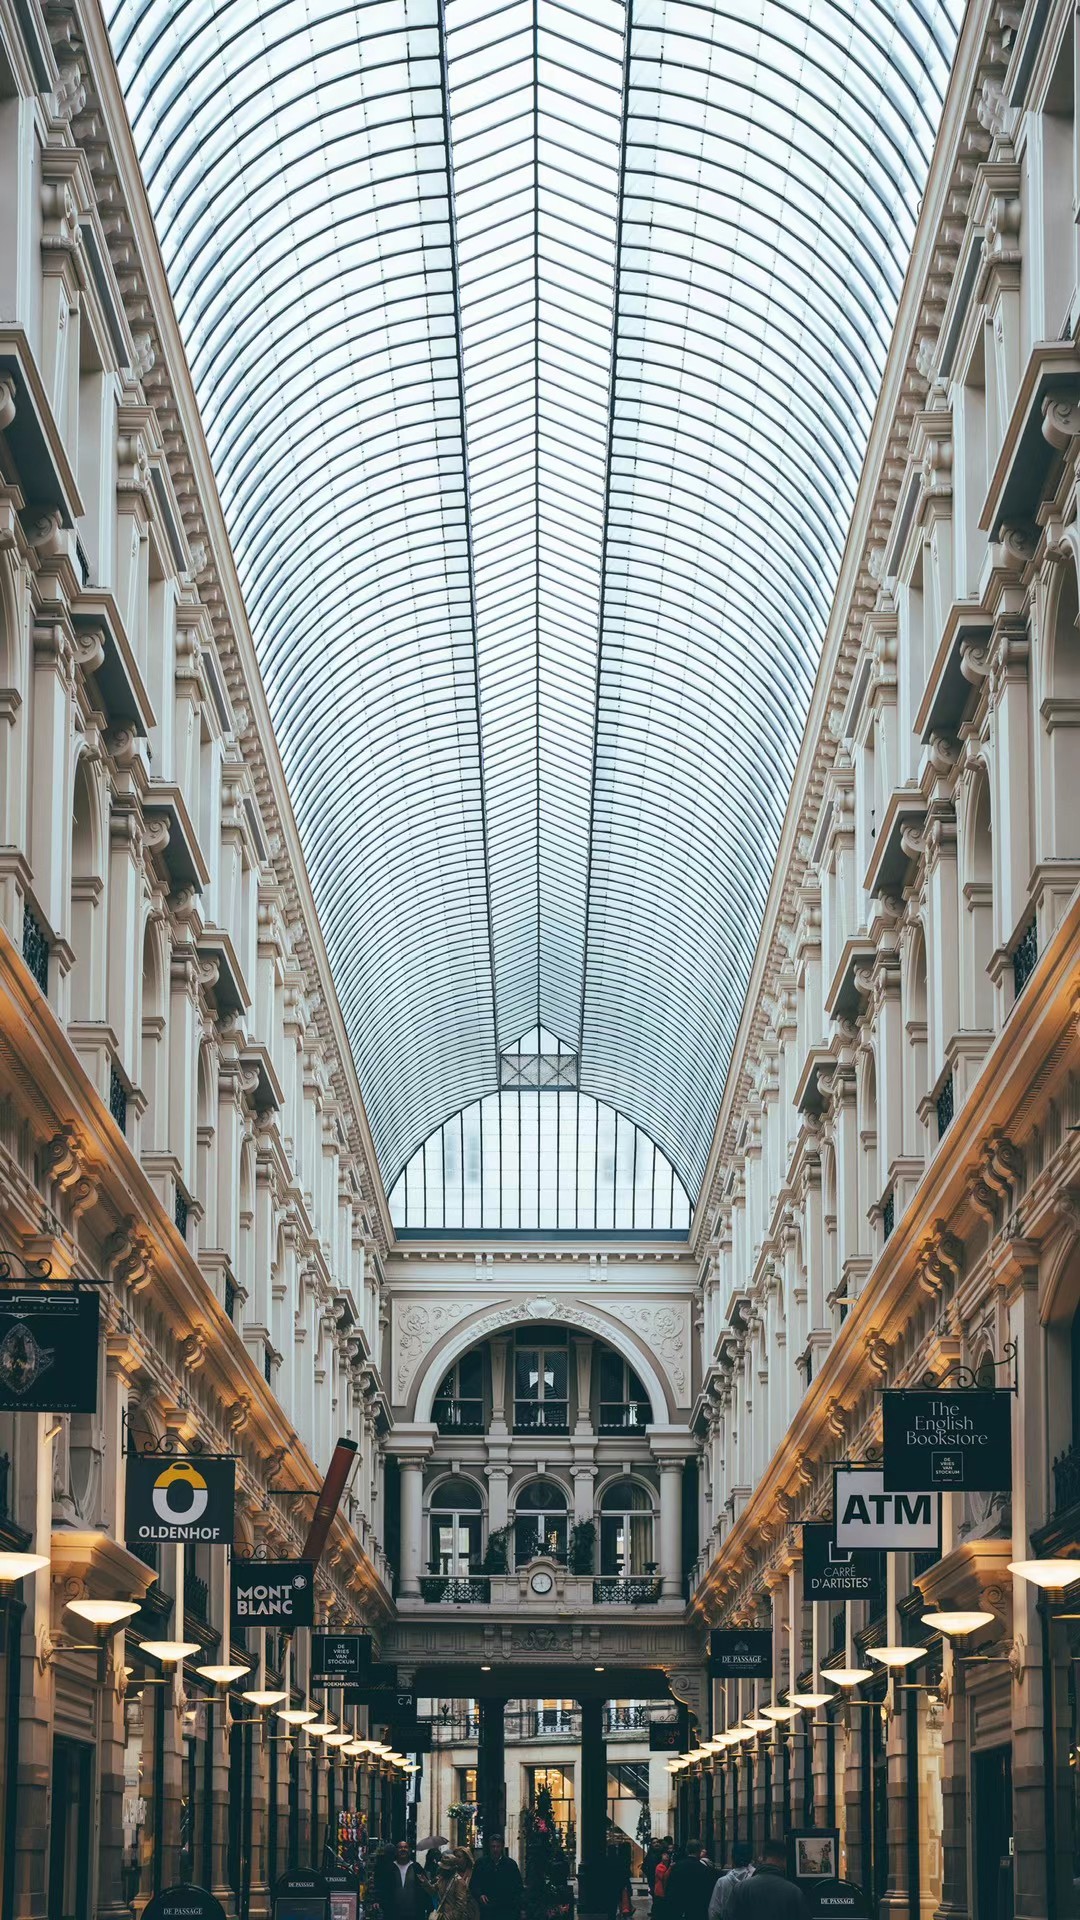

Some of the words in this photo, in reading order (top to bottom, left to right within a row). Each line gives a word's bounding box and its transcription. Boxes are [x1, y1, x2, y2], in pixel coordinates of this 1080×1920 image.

[928, 1401, 960, 1416] The
[915, 1415, 974, 1434] English
[906, 1430, 988, 1445] Bookstore
[841, 1494, 931, 1525] ATM
[138, 1525, 220, 1540] OLDENHOF
[823, 1564, 856, 1577] CARRÉ
[237, 1585, 292, 1600] MONT
[237, 1600, 292, 1615] BLANC
[722, 1655, 731, 1663] DE
[733, 1655, 762, 1663] PASSAGE
[174, 1907, 203, 1915] PASSAGE
